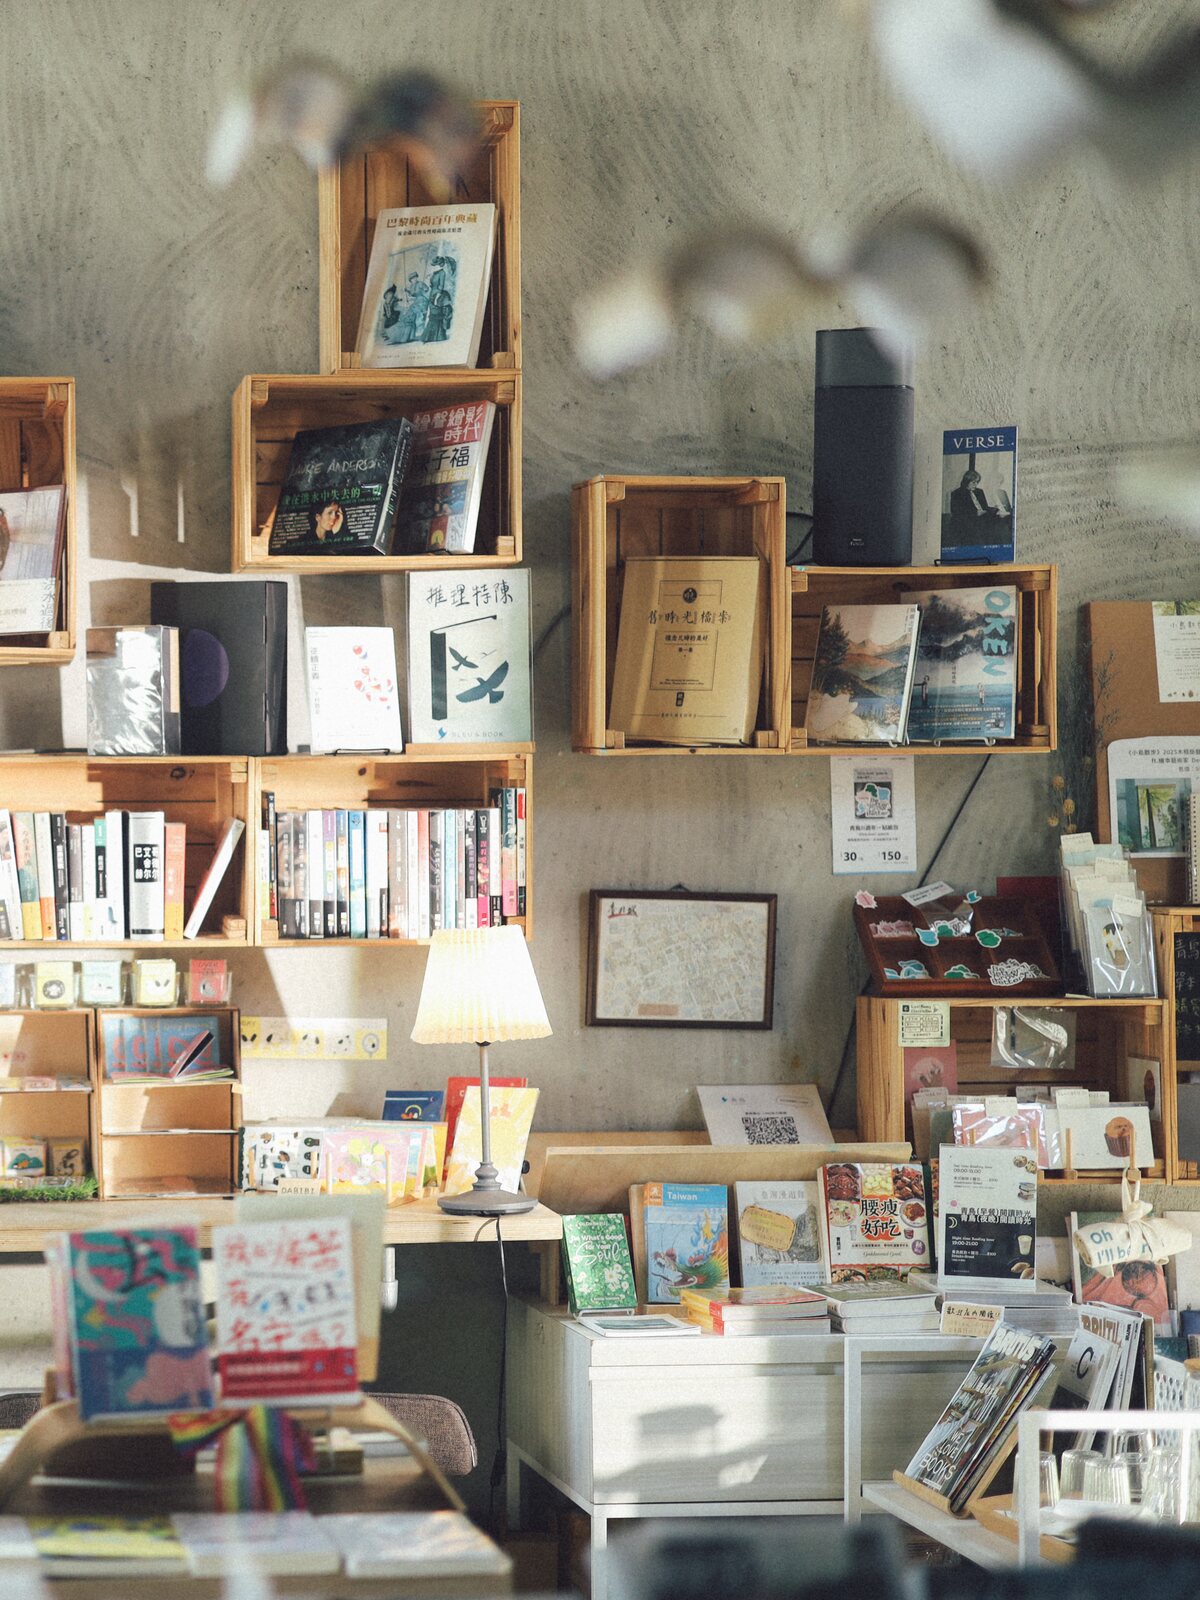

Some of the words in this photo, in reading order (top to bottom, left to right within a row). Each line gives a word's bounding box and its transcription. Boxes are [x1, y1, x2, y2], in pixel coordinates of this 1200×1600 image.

[386, 212, 479, 229] 巴黎時尚百年典藏
[952, 434, 1006, 450] VERSE
[981, 589, 1011, 677] OKEN
[843, 851, 857, 862] 30
[882, 850, 902, 861] 150
[667, 1191, 698, 1201] Taiwan
[859, 1199, 900, 1217] 腰瘦
[861, 1218, 901, 1237] 好吃
[1090, 1229, 1114, 1244] Oh
[1097, 1248, 1114, 1265] I'll
[990, 1327, 1044, 1362] BRUTUS
[951, 1431, 965, 1443] WE
[936, 1441, 960, 1460] LOVE
[920, 1453, 957, 1480] BOOKS
